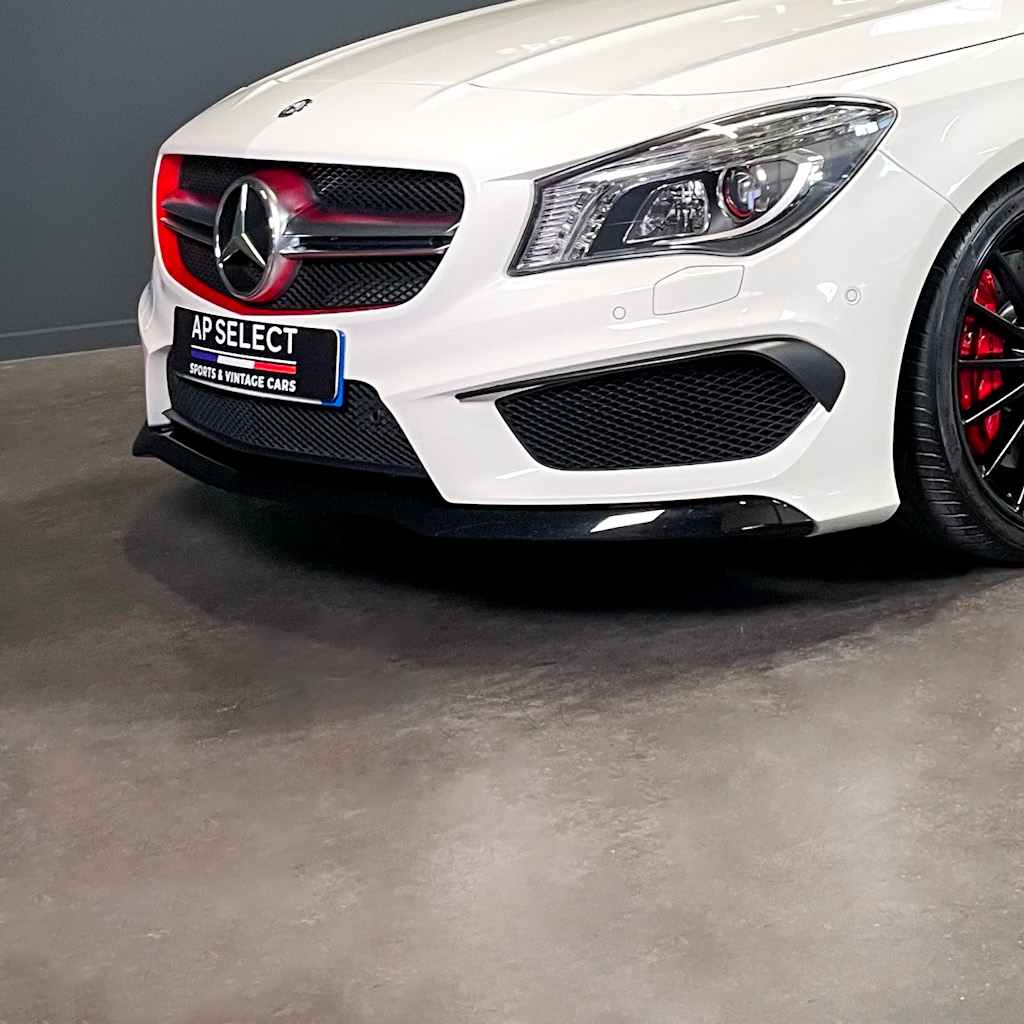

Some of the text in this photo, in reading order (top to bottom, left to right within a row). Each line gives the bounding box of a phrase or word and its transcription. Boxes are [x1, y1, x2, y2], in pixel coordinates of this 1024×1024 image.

[191, 314, 299, 355] AP SELECT
[189, 362, 297, 393] SPORTS & VINTAGE CARS
